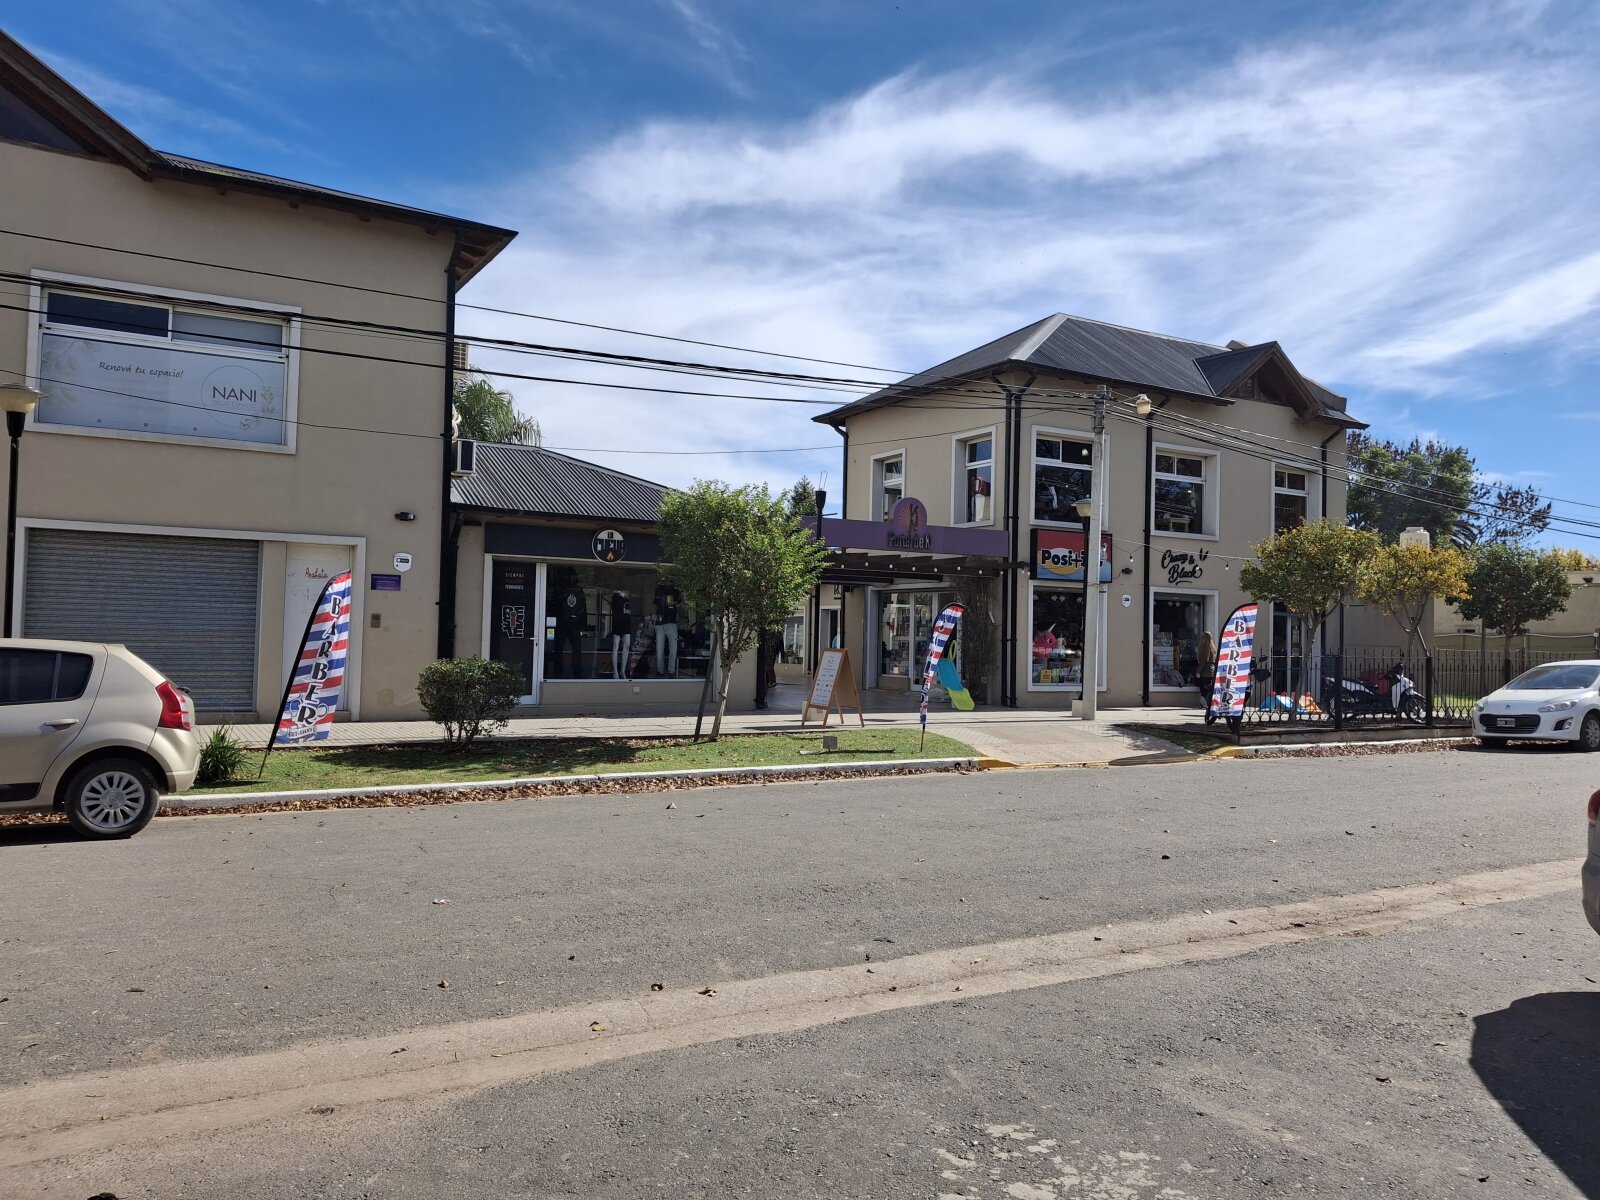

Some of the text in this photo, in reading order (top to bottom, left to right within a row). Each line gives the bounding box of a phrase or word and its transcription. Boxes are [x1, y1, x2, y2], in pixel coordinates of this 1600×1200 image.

[98, 361, 184, 379] Renová tu espacio!
[212, 385, 257, 403] NANI
[1168, 563, 1203, 584] Black
[297, 596, 342, 725] BARBER
[1221, 619, 1246, 705] BARBER
